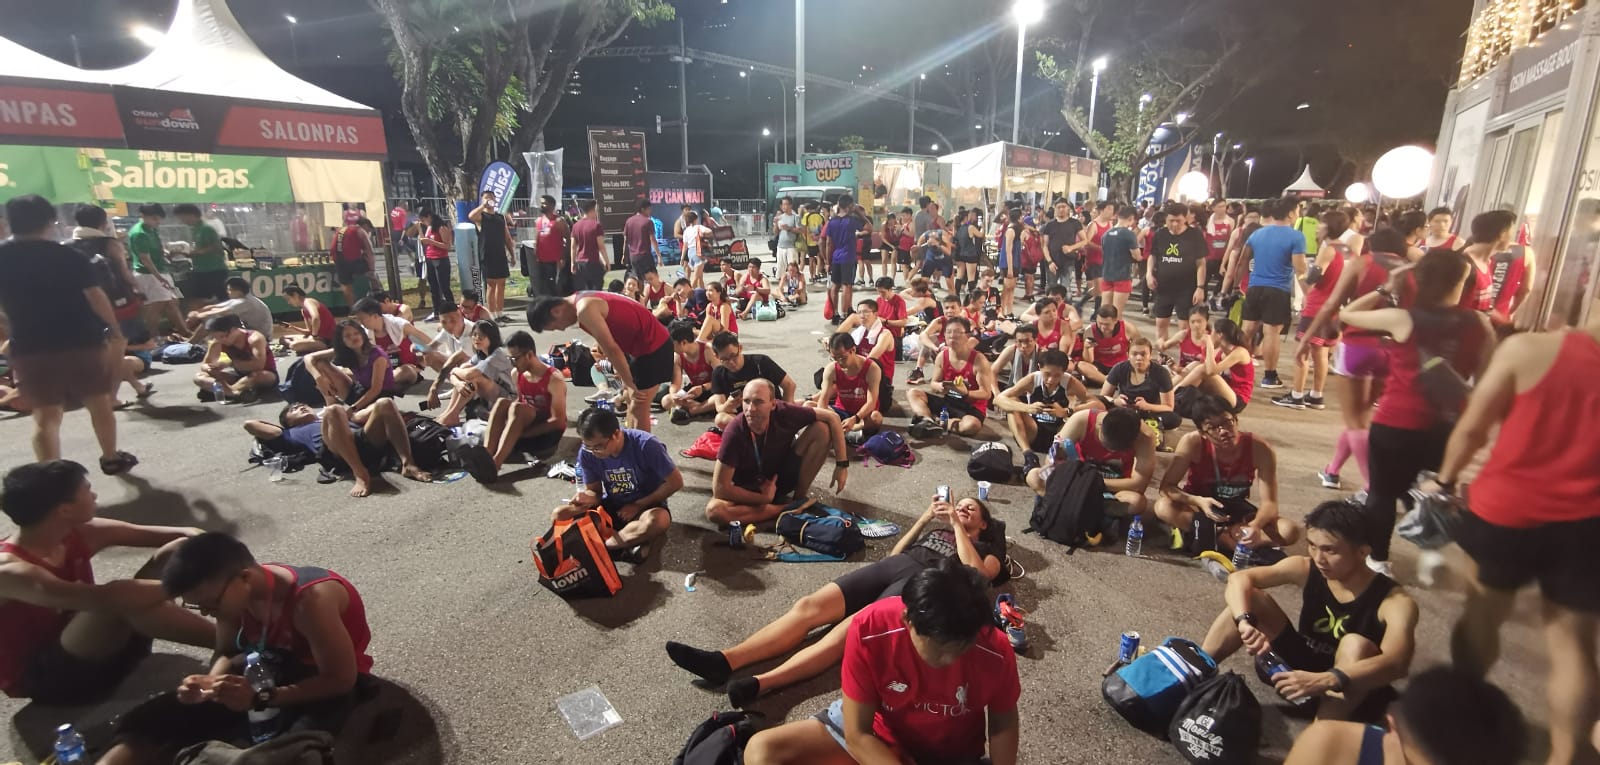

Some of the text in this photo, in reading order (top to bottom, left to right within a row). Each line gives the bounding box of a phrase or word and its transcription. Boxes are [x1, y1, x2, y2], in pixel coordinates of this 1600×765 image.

[259, 119, 359, 144] SALONPAS
[806, 157, 853, 171] SAWADEE
[93, 159, 250, 194] Salonpas
[816, 168, 841, 181] CUP
[649, 188, 705, 204] EEP CAN WAIT
[610, 473, 632, 482] SLEEP
